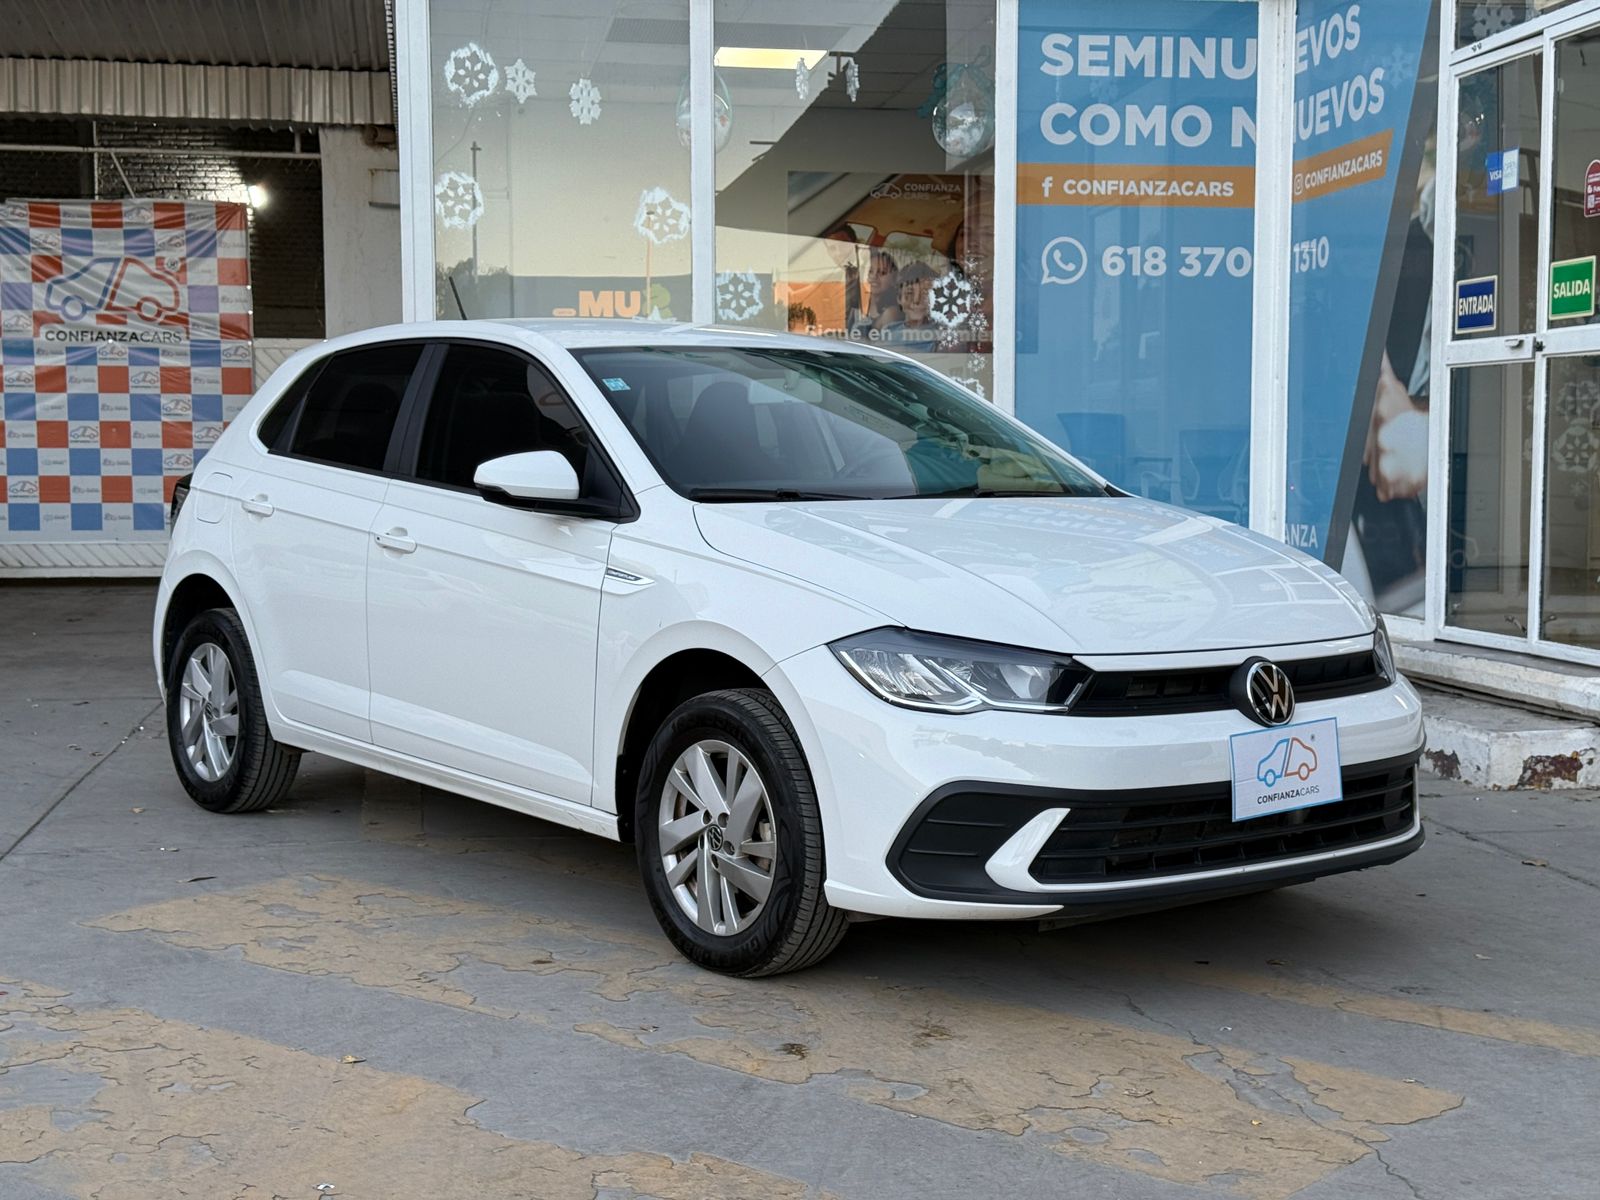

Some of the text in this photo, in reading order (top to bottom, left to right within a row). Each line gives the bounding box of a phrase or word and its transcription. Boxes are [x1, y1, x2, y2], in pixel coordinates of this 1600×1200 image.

[1040, 33, 1256, 80] SEMINU
[1040, 102, 1212, 147] COMO
[1304, 150, 1383, 189] CONFIANZACARS
[904, 183, 961, 193] CONFIANZA
[1063, 180, 1234, 197] CONFIANZACARS
[1101, 245, 1252, 277] 618 370
[1293, 236, 1329, 273] 1310
[1553, 279, 1590, 299] SALIDA
[1459, 294, 1494, 316] ENTRADA
[45, 330, 182, 344] CONFIANZACARS
[868, 328, 892, 341] en
[1257, 785, 1320, 805] CONFIANZACARS
